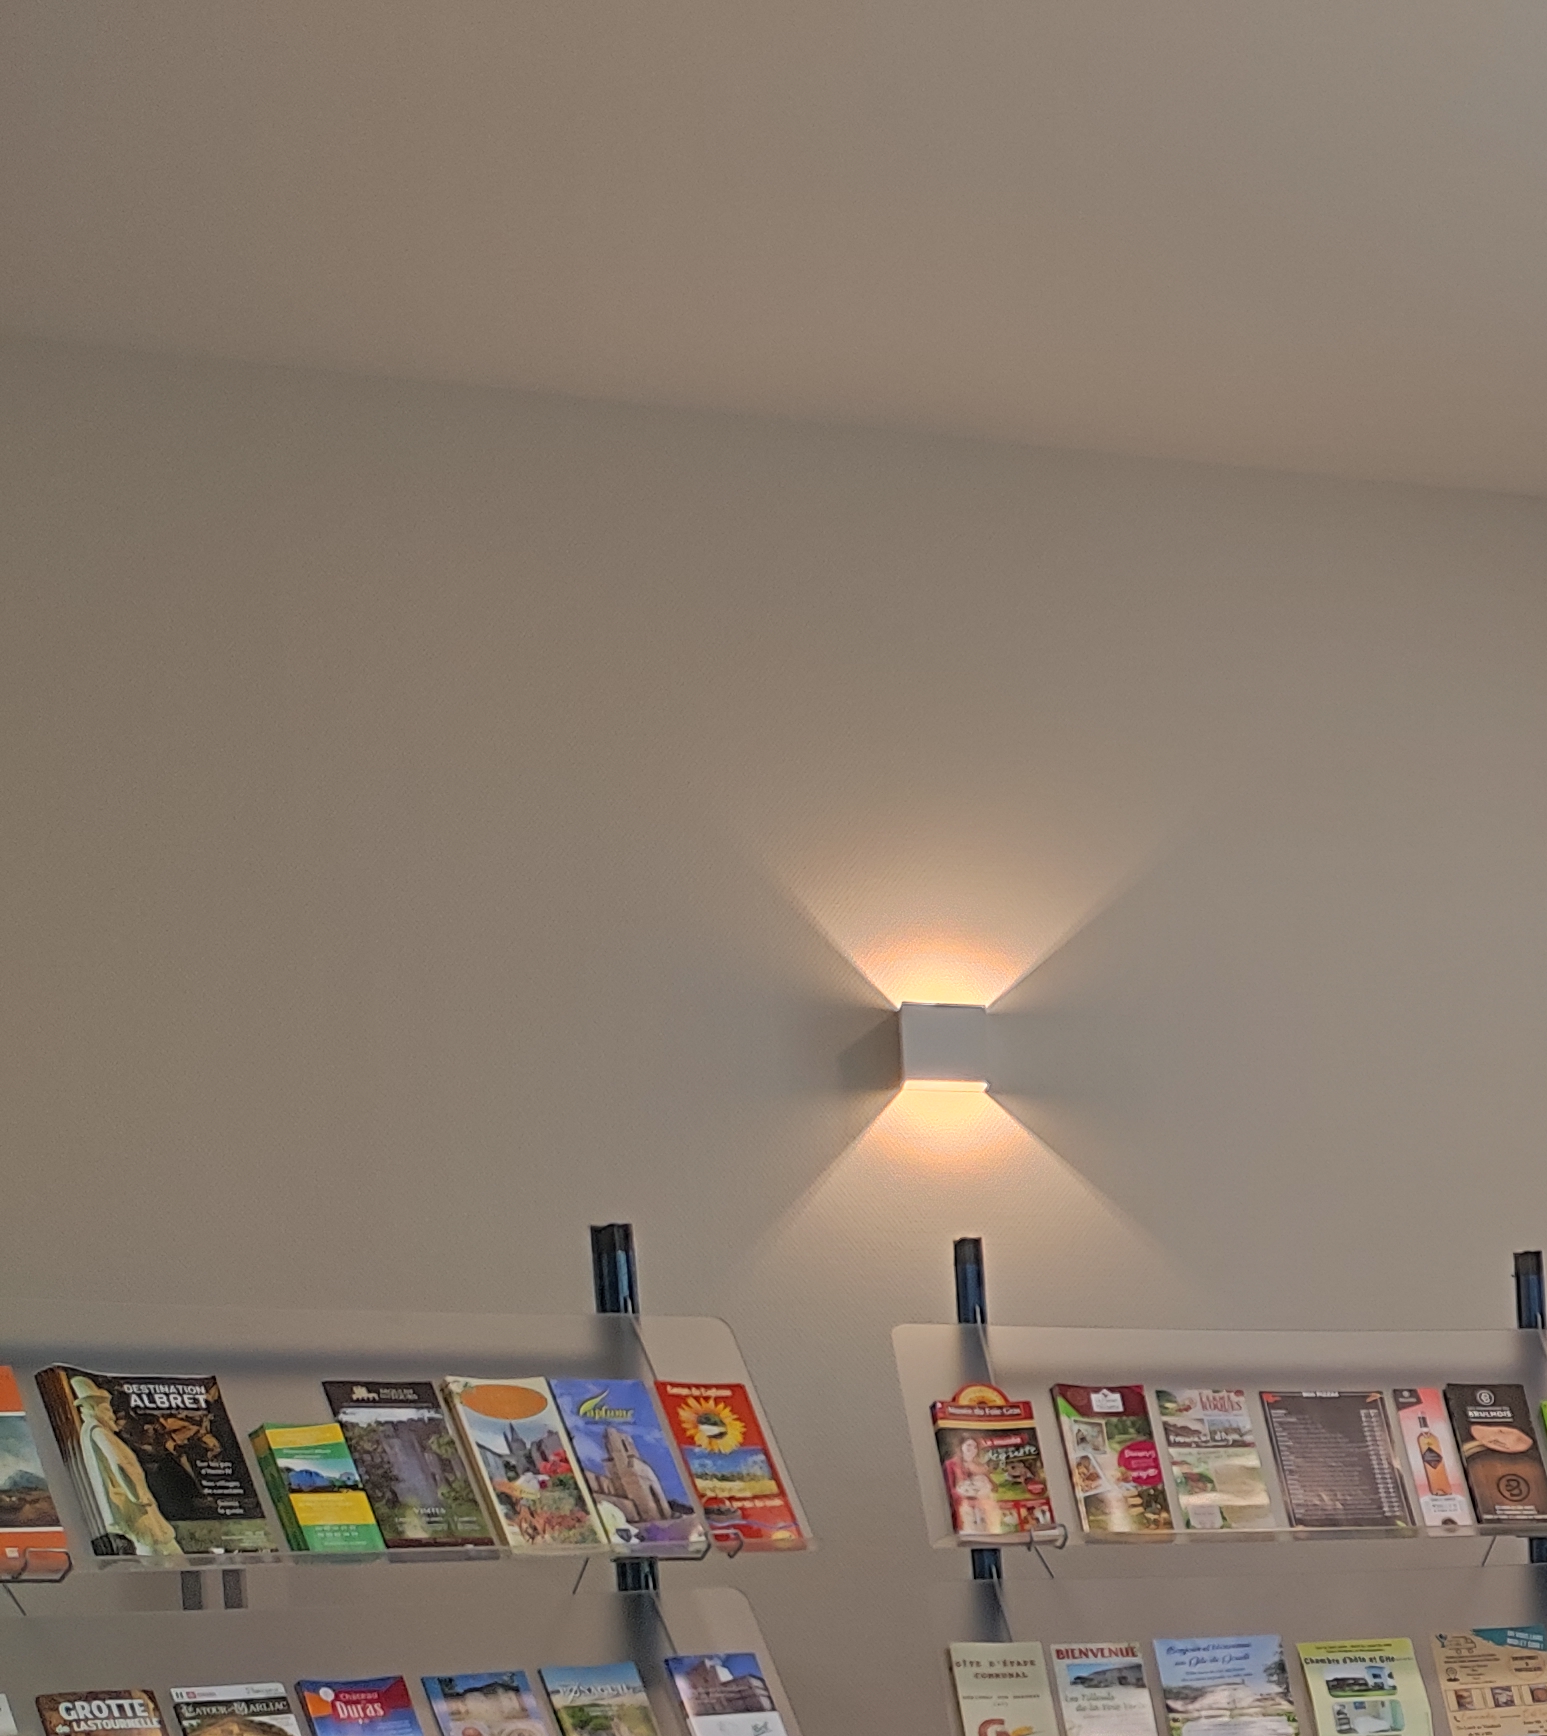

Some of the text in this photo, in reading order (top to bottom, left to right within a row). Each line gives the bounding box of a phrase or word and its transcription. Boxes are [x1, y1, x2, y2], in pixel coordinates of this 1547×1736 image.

[124, 1383, 206, 1395] DESTINATION
[130, 1394, 208, 1409] ALBRET
[1055, 1645, 1138, 1661] BIENVENUE
[1304, 1656, 1338, 1665] Chambre
[59, 1699, 149, 1721] GROTTE
[335, 1699, 385, 1720] Duras
